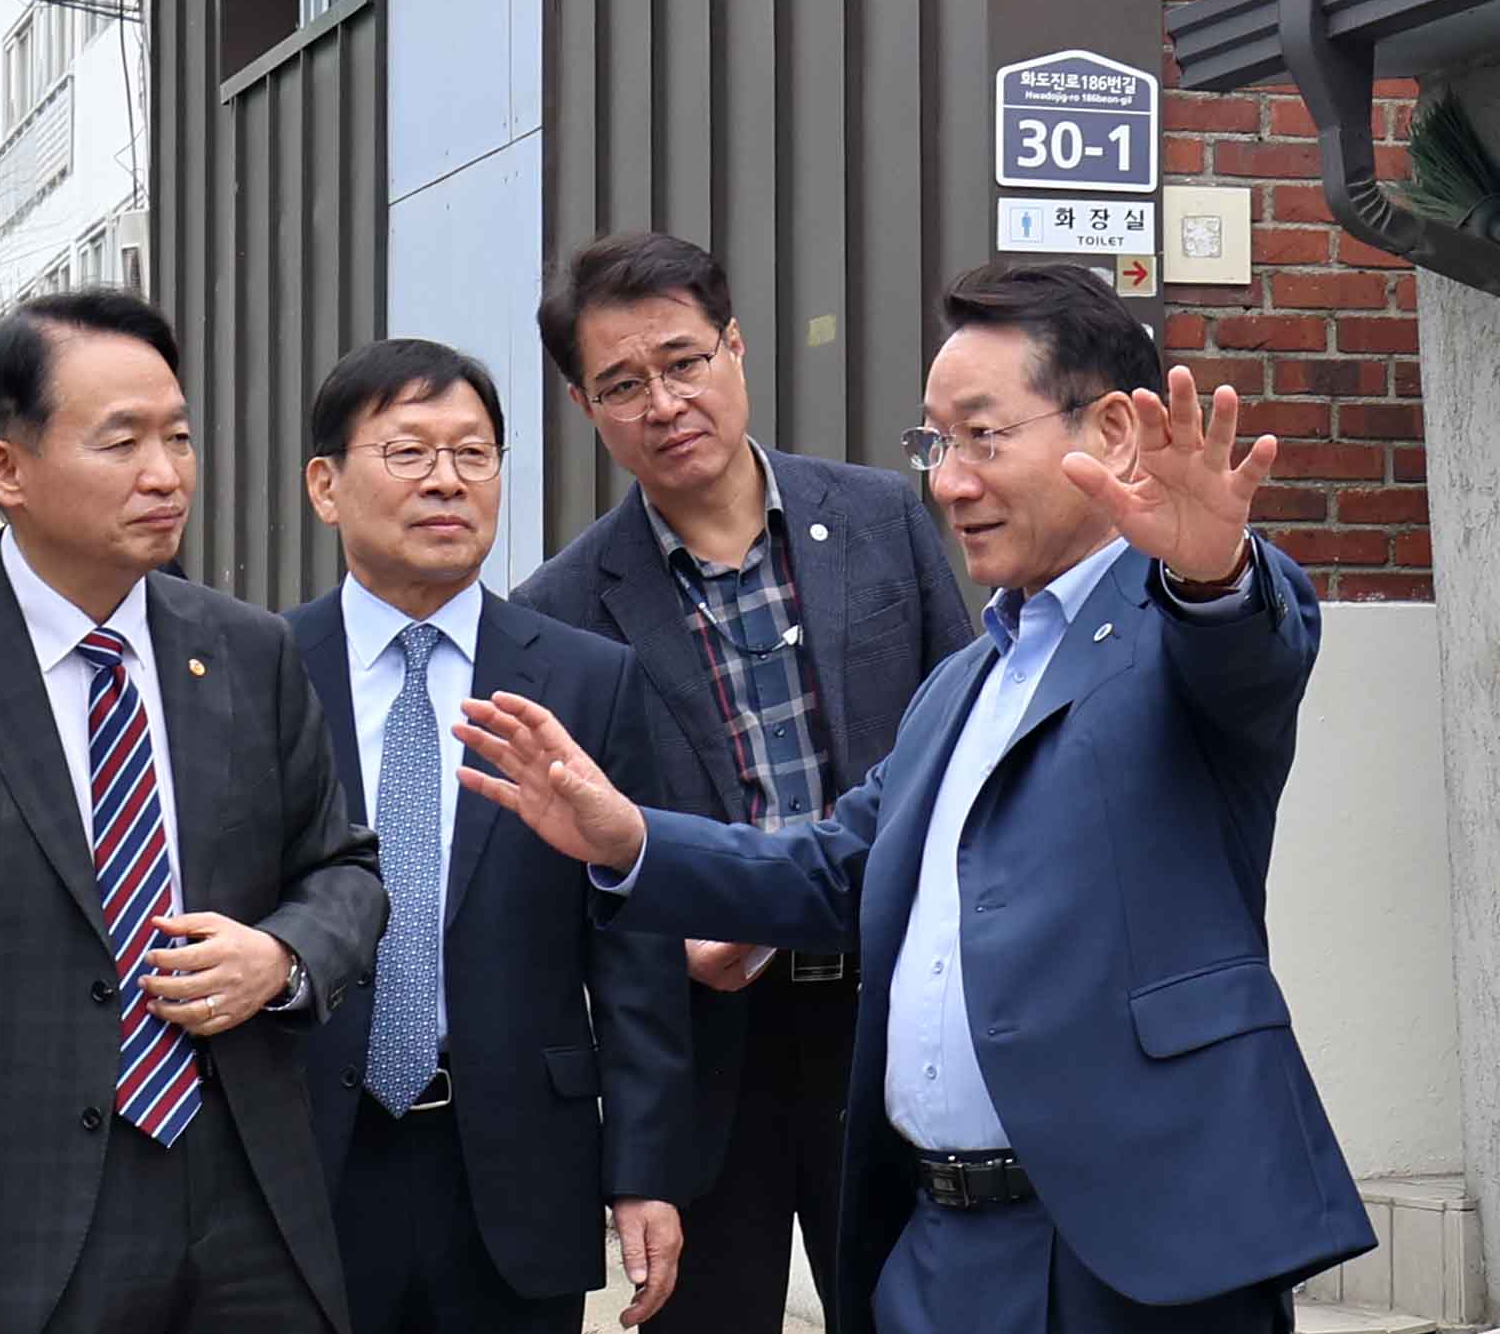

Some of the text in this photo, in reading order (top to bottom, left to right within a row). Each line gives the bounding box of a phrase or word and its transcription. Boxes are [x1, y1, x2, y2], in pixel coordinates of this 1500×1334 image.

[1020, 71, 1137, 95] 화도진로186번길
[1017, 119, 1130, 171] 30-1
[1077, 235, 1124, 247] TOILET
